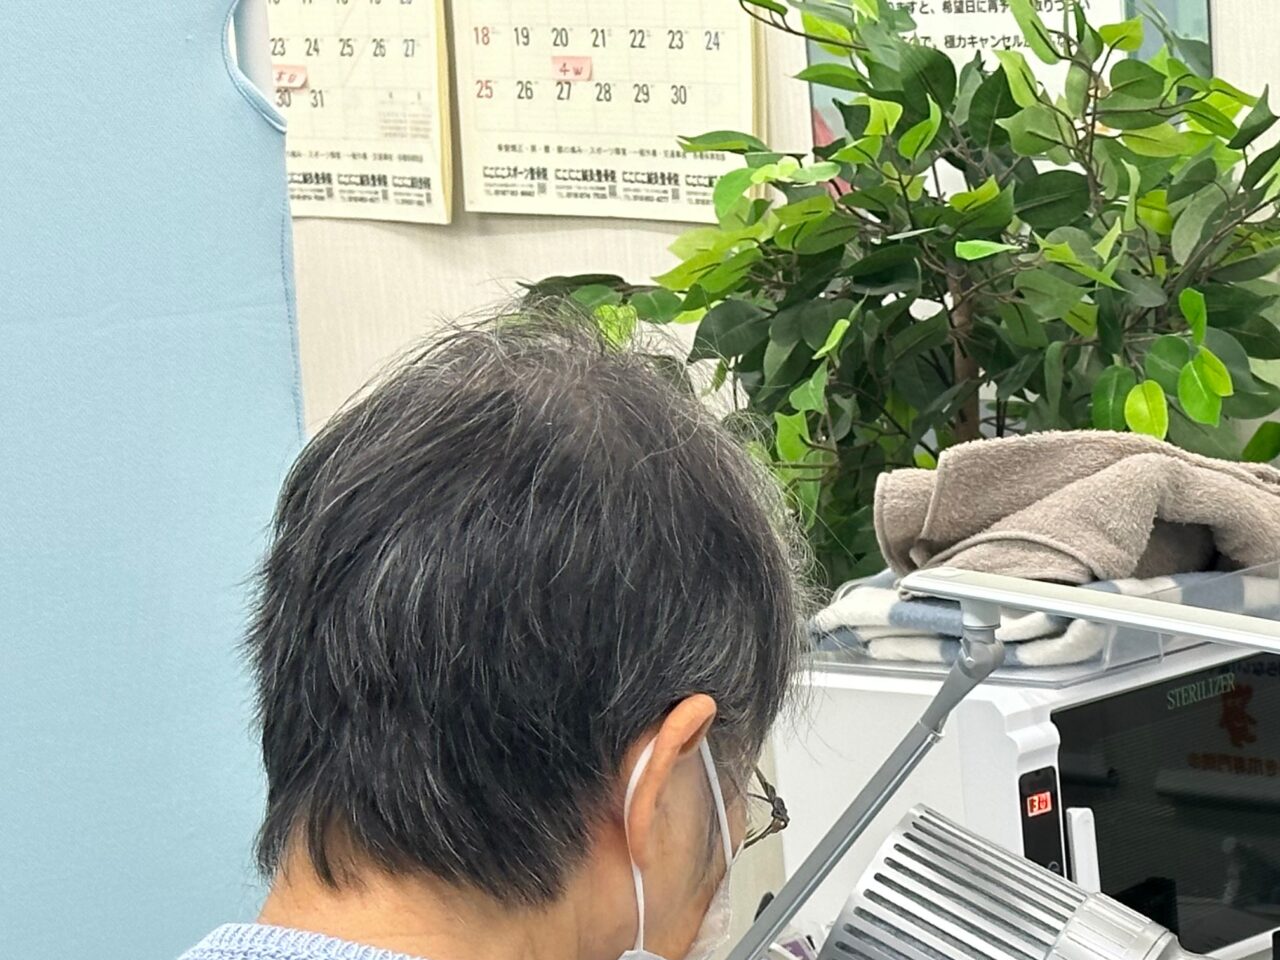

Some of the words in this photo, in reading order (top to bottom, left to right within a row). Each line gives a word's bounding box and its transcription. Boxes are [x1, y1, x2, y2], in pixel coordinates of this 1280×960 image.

[270, 38, 286, 56] 23
[305, 38, 319, 56] 24
[339, 38, 354, 57] 25
[372, 38, 386, 57] 26
[403, 39, 415, 57] 27
[474, 27, 490, 45] 18
[514, 27, 530, 46] 19
[551, 28, 568, 46] 20
[591, 28, 606, 47] 21
[630, 29, 646, 48] 22
[668, 30, 684, 49] 23
[705, 31, 720, 50] 24
[311, 89, 324, 108] 31
[476, 80, 493, 98] 25
[516, 81, 533, 99] 26
[556, 82, 572, 100] 27
[595, 83, 612, 102] 28
[633, 84, 650, 103] 29
[671, 85, 687, 104] 30
[1167, 672, 1235, 710] STERILIZER
